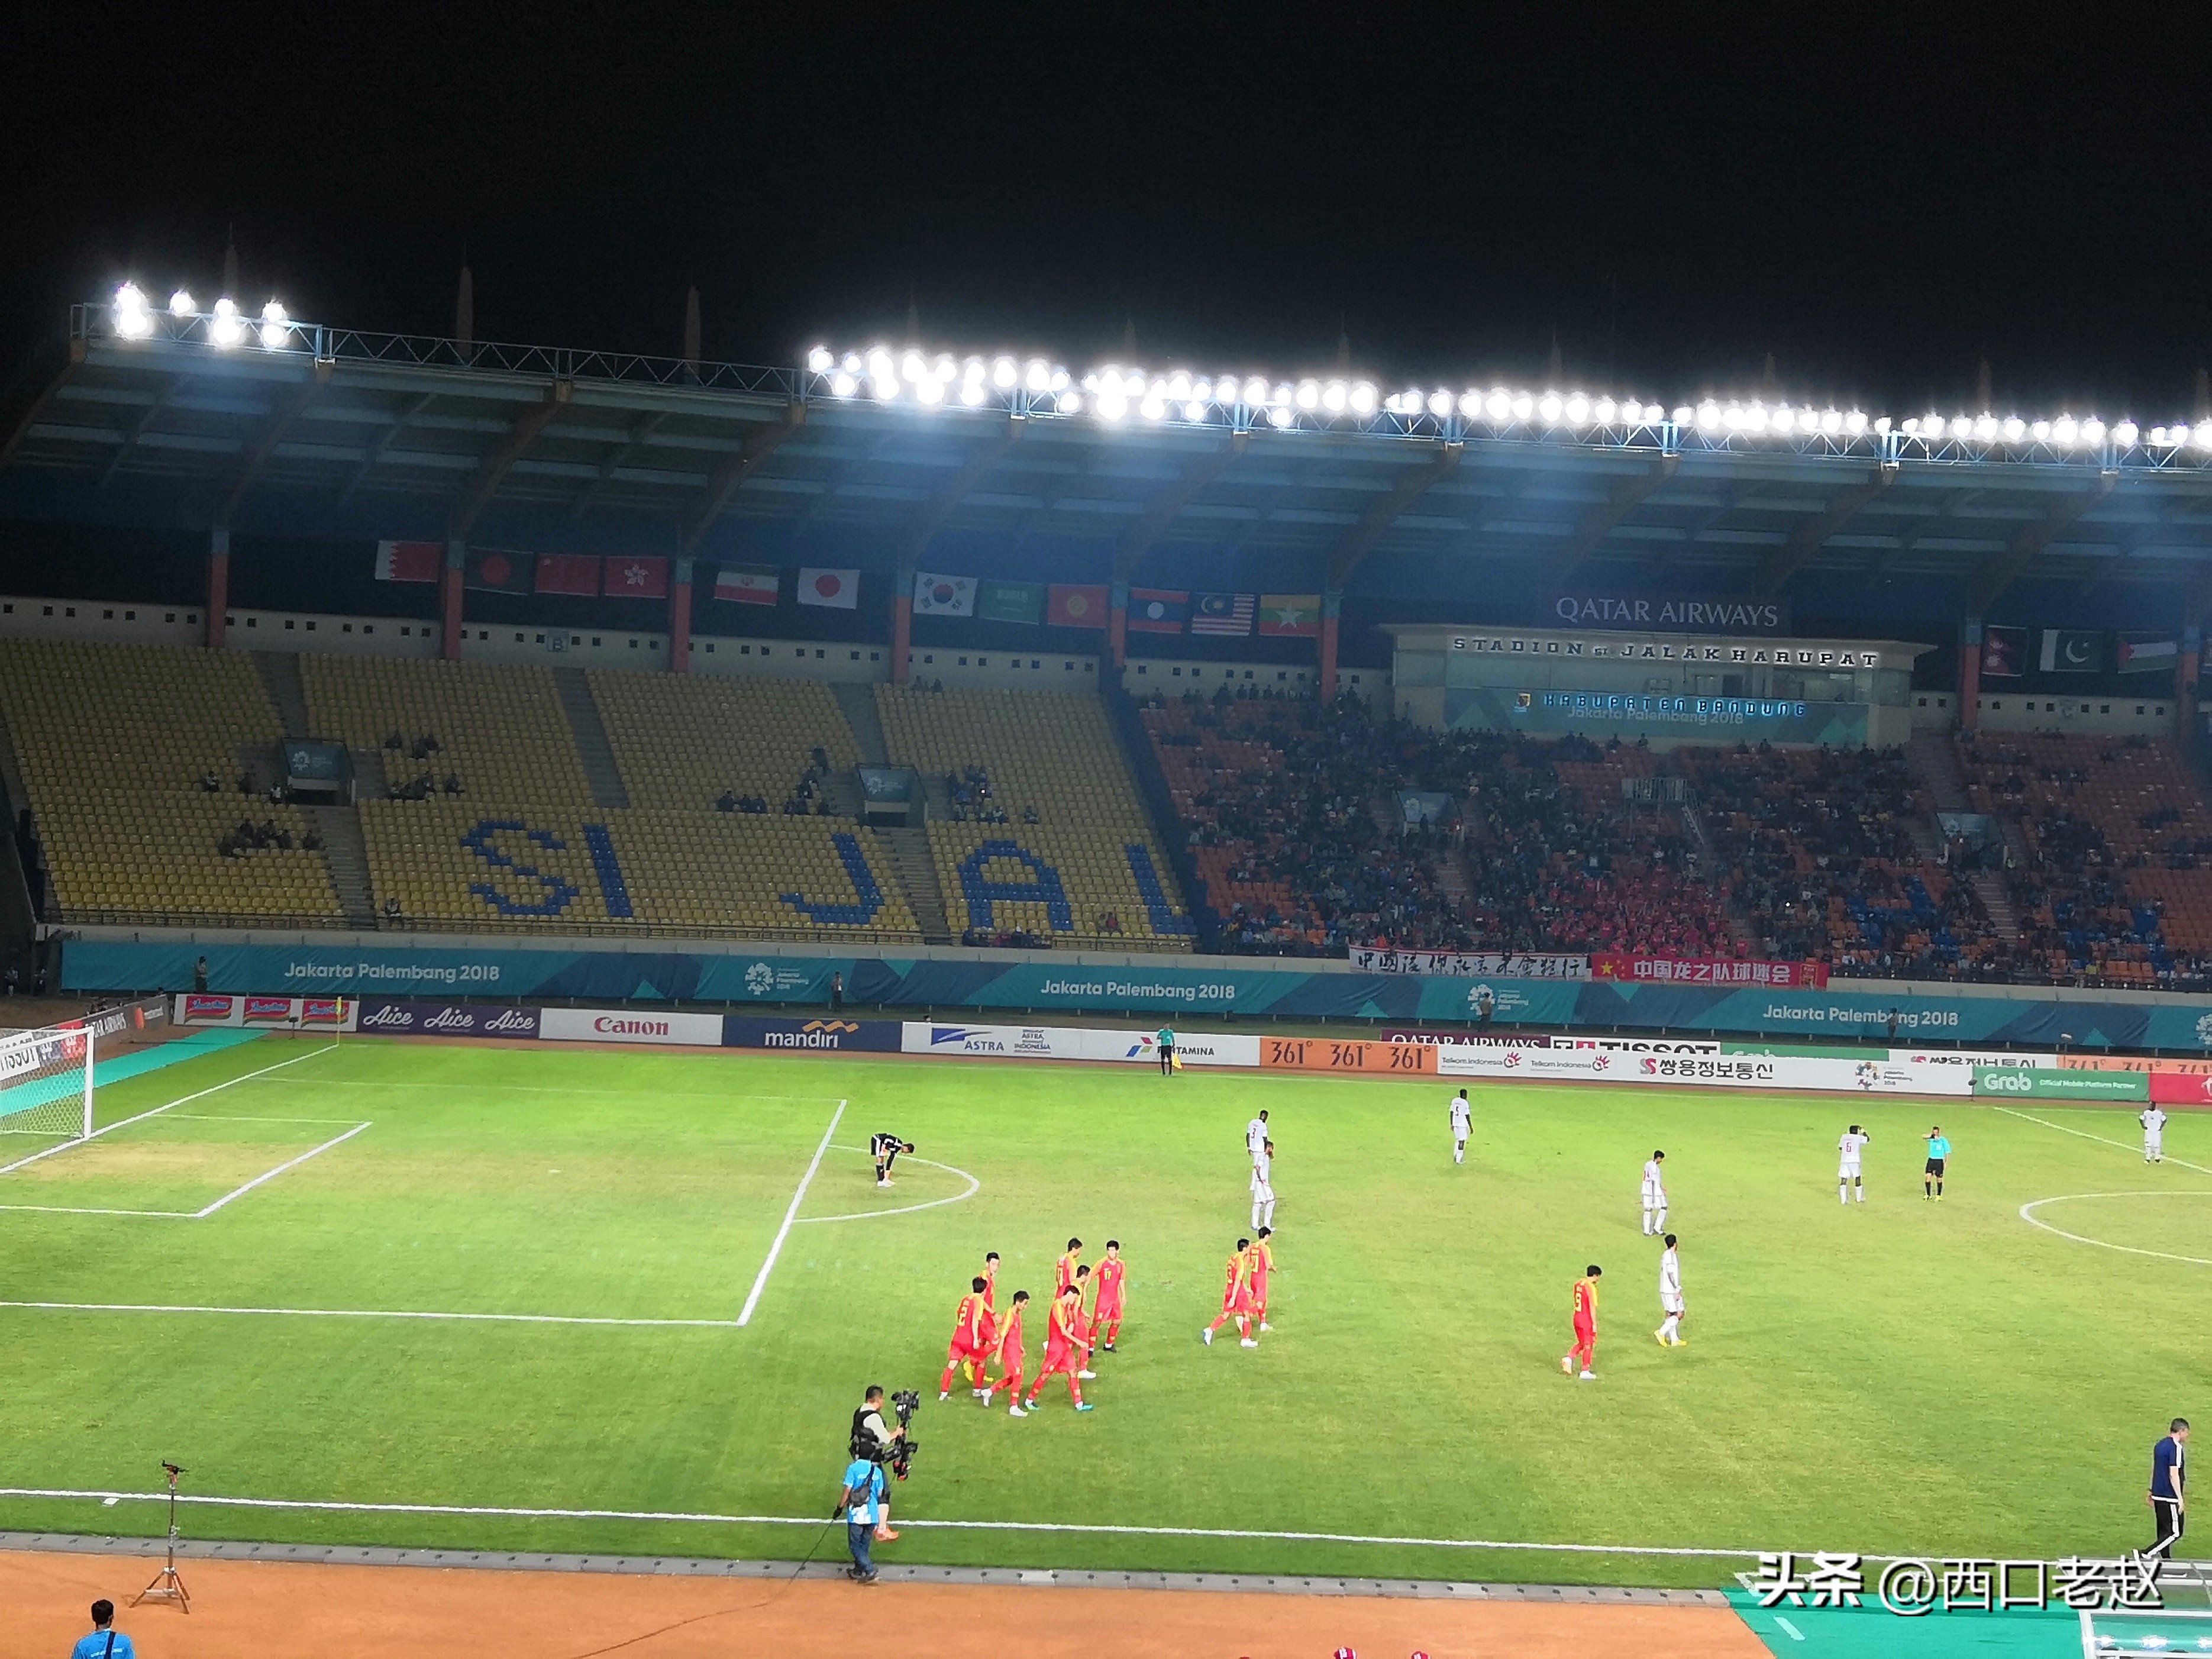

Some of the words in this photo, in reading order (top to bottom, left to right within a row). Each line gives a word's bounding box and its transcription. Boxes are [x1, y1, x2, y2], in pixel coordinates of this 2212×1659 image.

[1556, 597, 1651, 624] QATAR
[1659, 601, 1778, 627] AIRWAYS
[1454, 638, 1583, 655] STADION
[1621, 645, 1721, 660] JALAK
[1732, 649, 1877, 666] HARUPAT
[1545, 695, 1685, 711] KABUPATEN
[1698, 700, 1804, 715] BANDUNG
[1710, 712, 1744, 725] 2018
[285, 962, 354, 979] Jakarta
[358, 963, 457, 983] Palembang
[460, 965, 500, 981] 2018
[1633, 960, 1791, 983] 中国龙之队球迷会
[1041, 980, 1103, 995] Jakarta
[1107, 981, 1196, 1000] Palembang
[1199, 983, 1235, 999] 2018
[363, 1005, 414, 1025] Aice
[424, 1007, 474, 1028] Aice
[484, 1009, 535, 1030] Aice
[1763, 1005, 1825, 1021] Jakarta
[1922, 1011, 1959, 1027] 2018
[593, 1016, 670, 1036] Canon
[764, 1029, 839, 1049] mandiri
[964, 1039, 1005, 1051] ASTRA
[1659, 1058, 1774, 1080] 쌍용정보통신
[1984, 1072, 2032, 1091] Grab
[957, 1305, 965, 1326] 2
